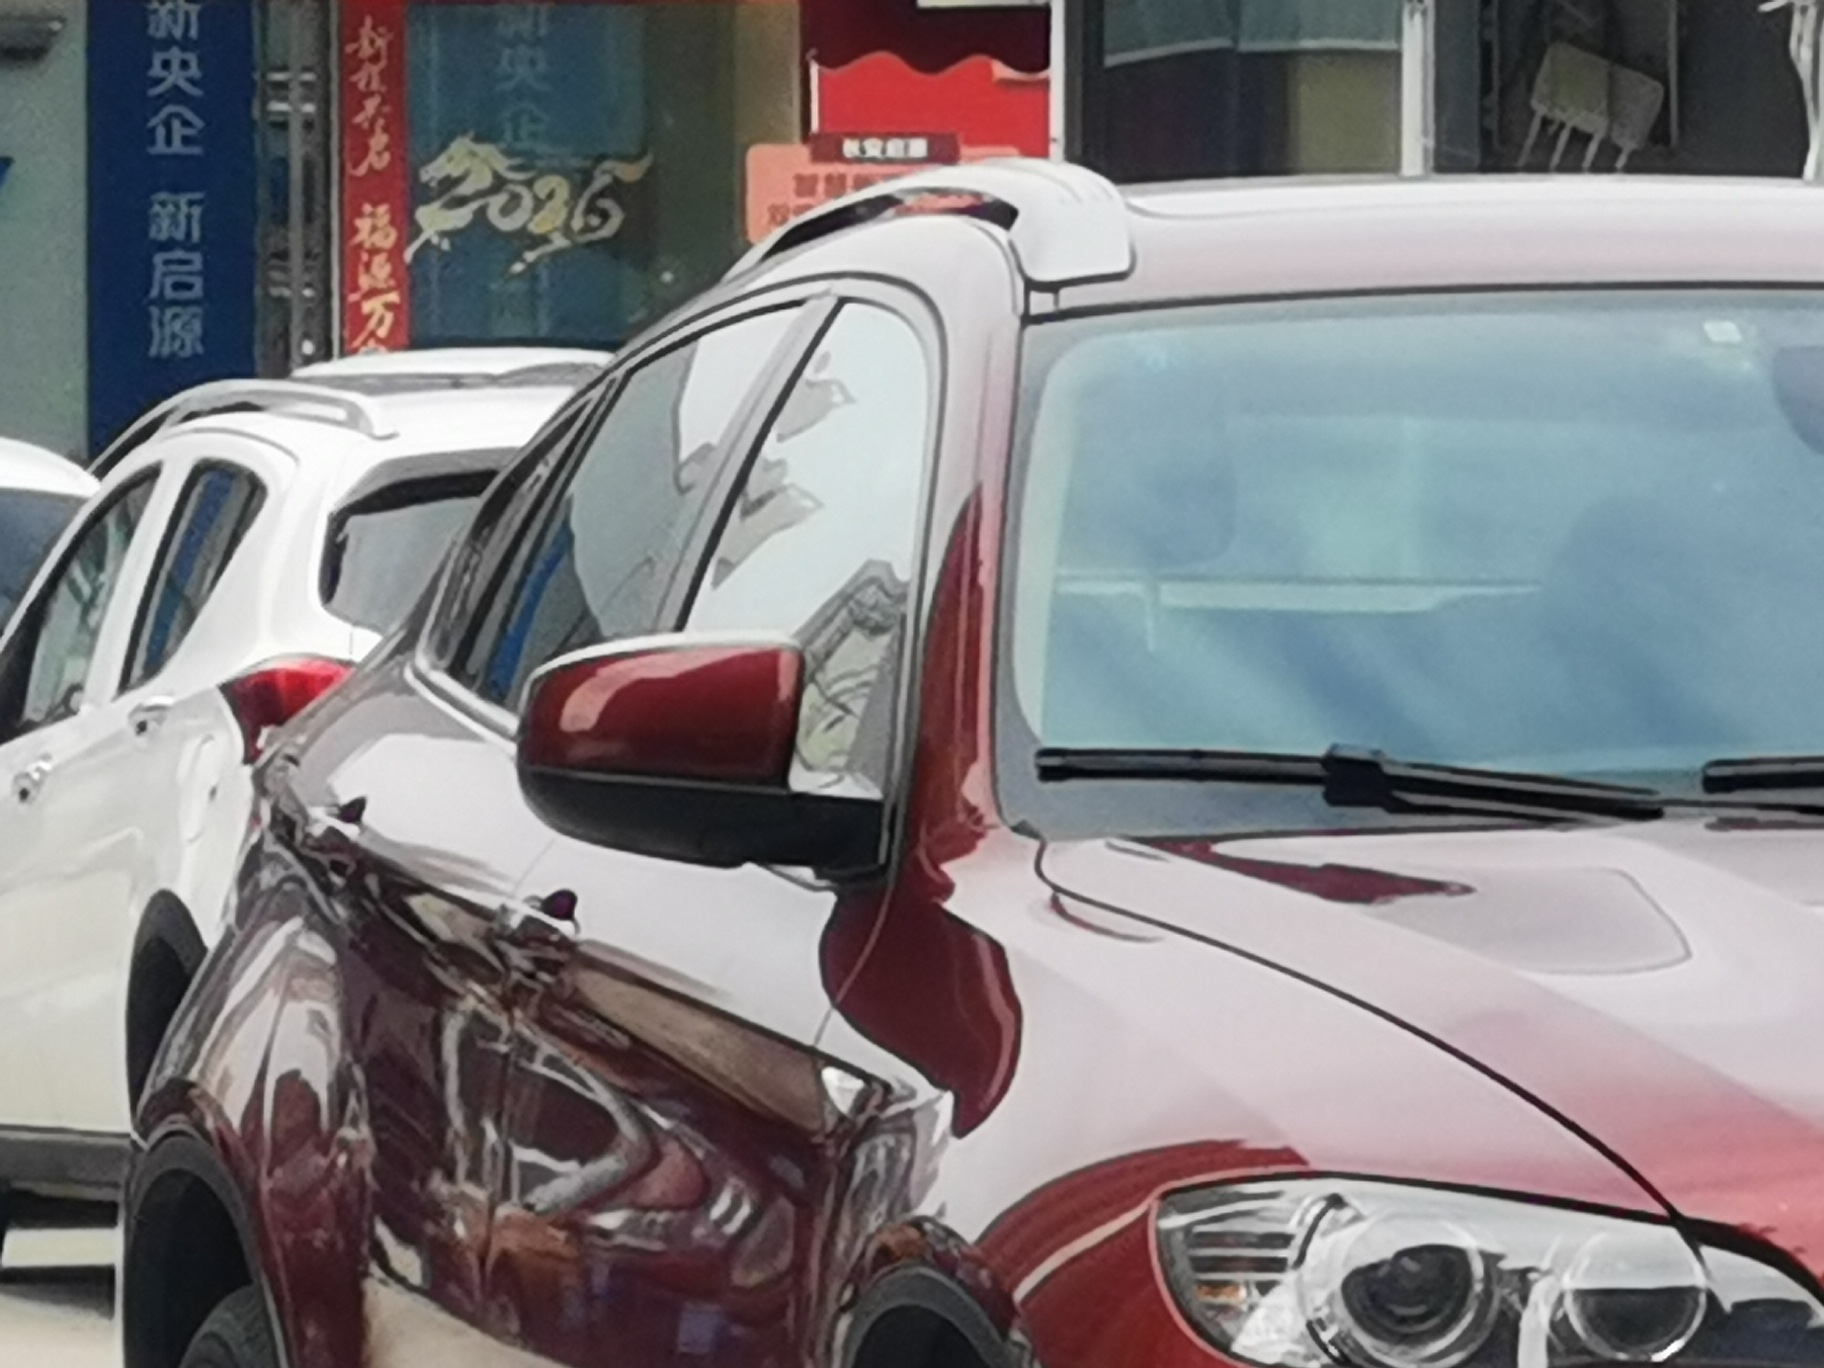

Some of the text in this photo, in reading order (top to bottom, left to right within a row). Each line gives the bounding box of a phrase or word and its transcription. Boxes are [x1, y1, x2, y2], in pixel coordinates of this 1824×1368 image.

[146, 0, 206, 358] 新央企 新启源
